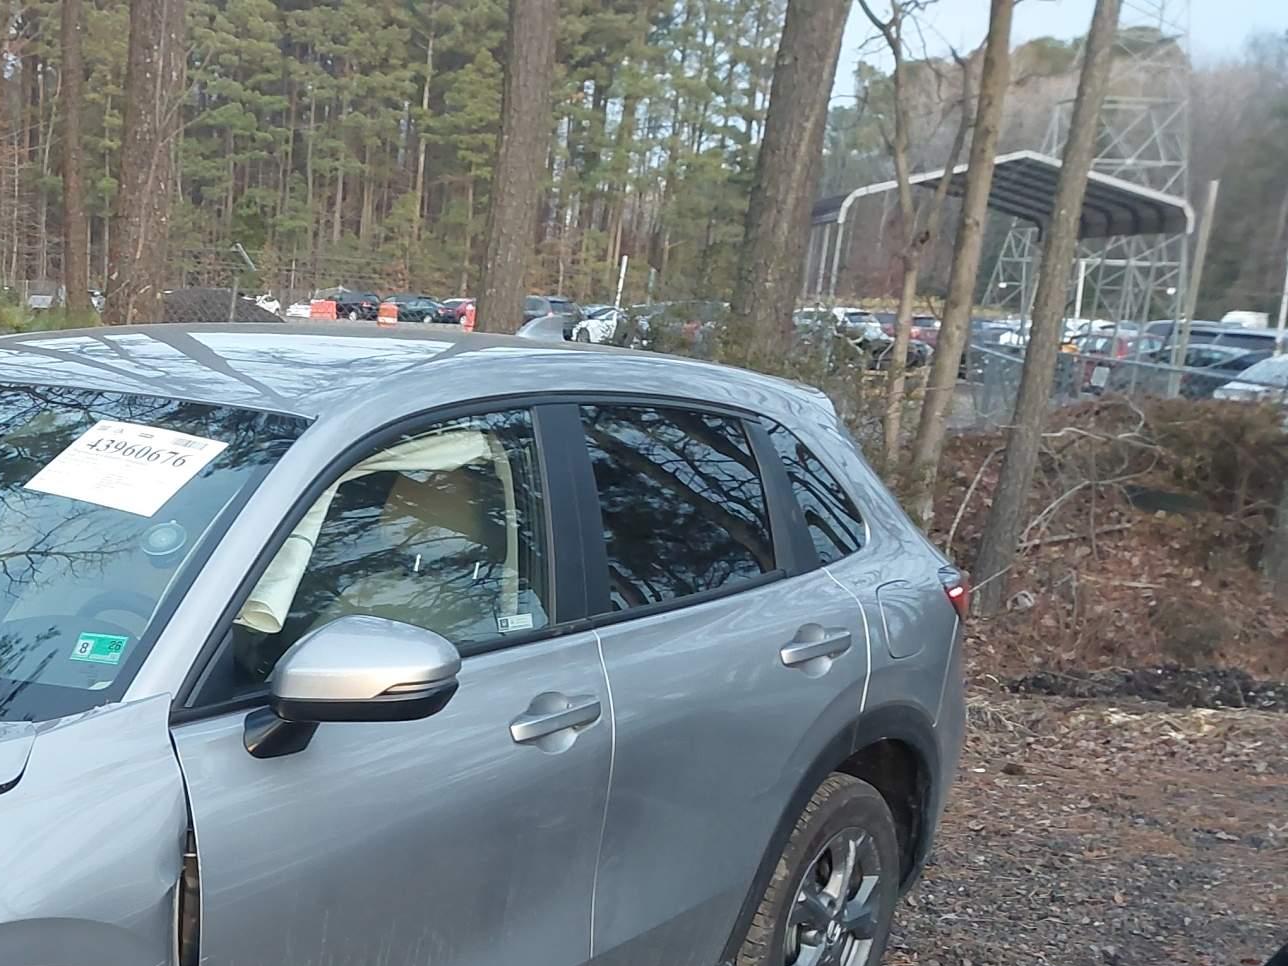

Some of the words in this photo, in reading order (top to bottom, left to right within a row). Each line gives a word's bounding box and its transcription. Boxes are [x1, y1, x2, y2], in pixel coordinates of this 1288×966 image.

[86, 438, 193, 468] 43960676
[79, 642, 89, 654] 8
[108, 640, 123, 651] 26
